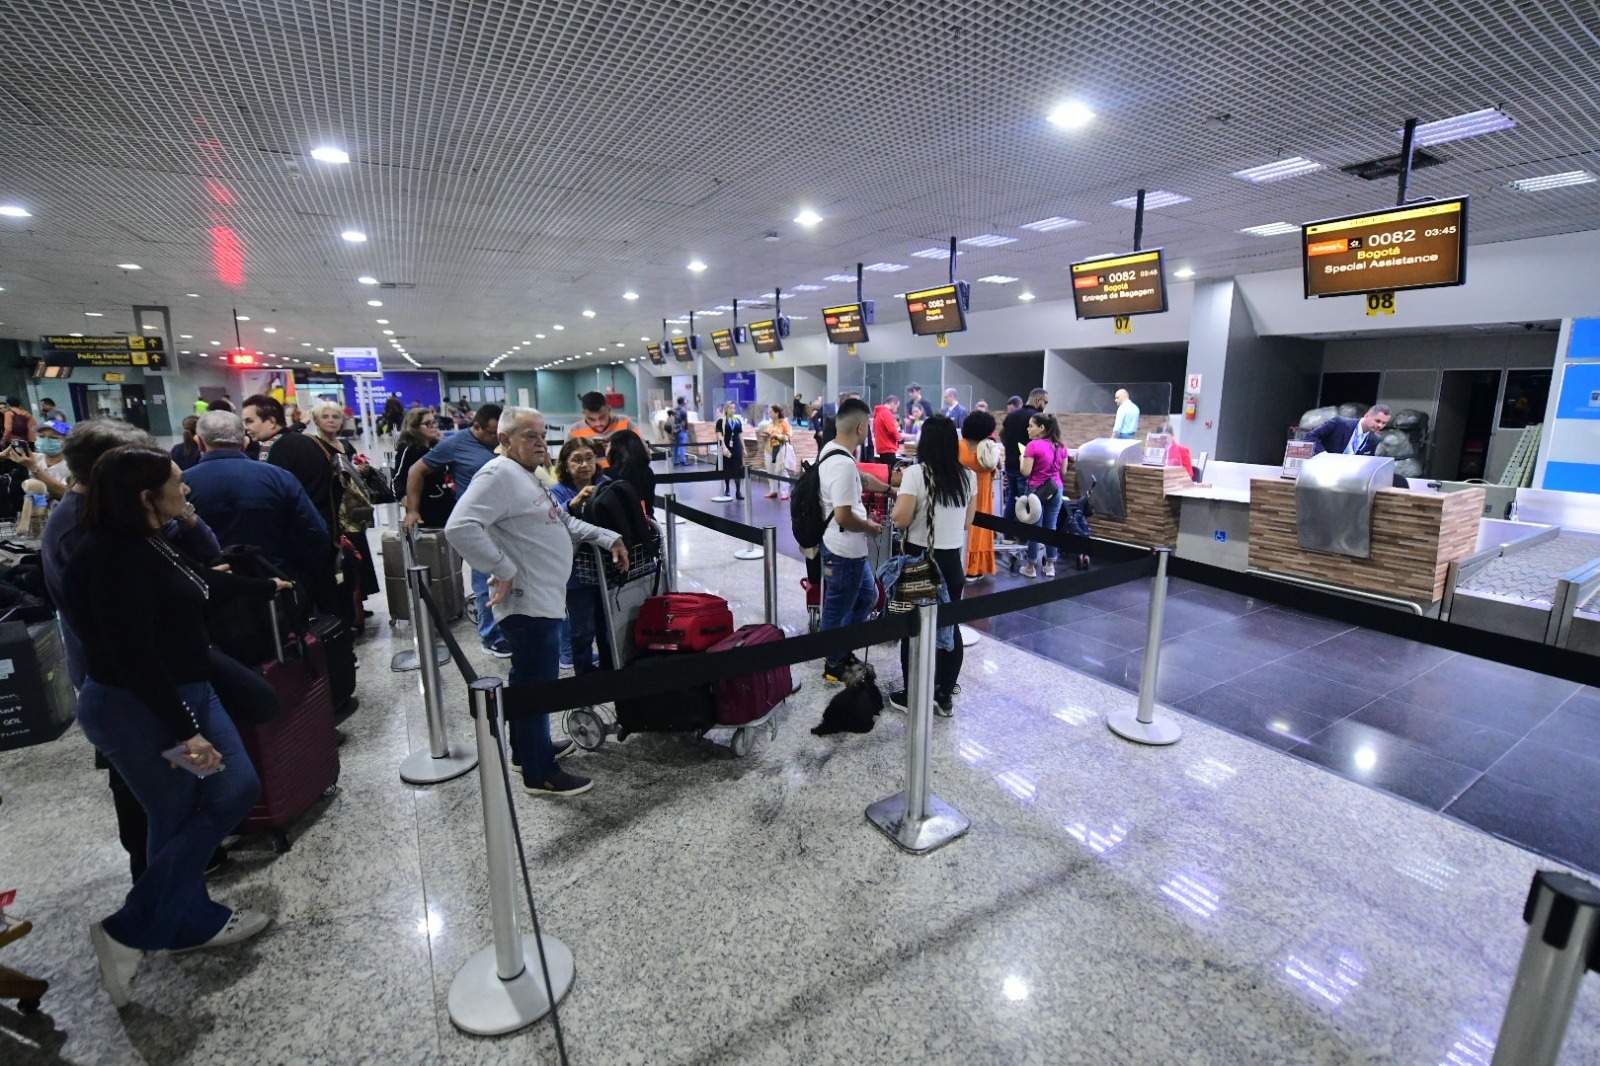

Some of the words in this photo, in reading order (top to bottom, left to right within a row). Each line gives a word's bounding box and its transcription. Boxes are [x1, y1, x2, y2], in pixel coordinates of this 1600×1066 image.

[1368, 229, 1416, 247] 0082
[1424, 225, 1457, 237] 03:45
[1357, 246, 1401, 260] Bogotá
[1324, 260, 1366, 275] Special
[1369, 253, 1439, 269] Assistance
[1108, 270, 1136, 283] 0082
[1103, 282, 1129, 293] Bogotá
[1082, 293, 1108, 303] Entrega
[1109, 291, 1119, 299] de
[1119, 288, 1155, 298] Bagagem
[1368, 293, 1394, 310] 08
[928, 299, 944, 308] 0082
[1115, 318, 1129, 330] 07
